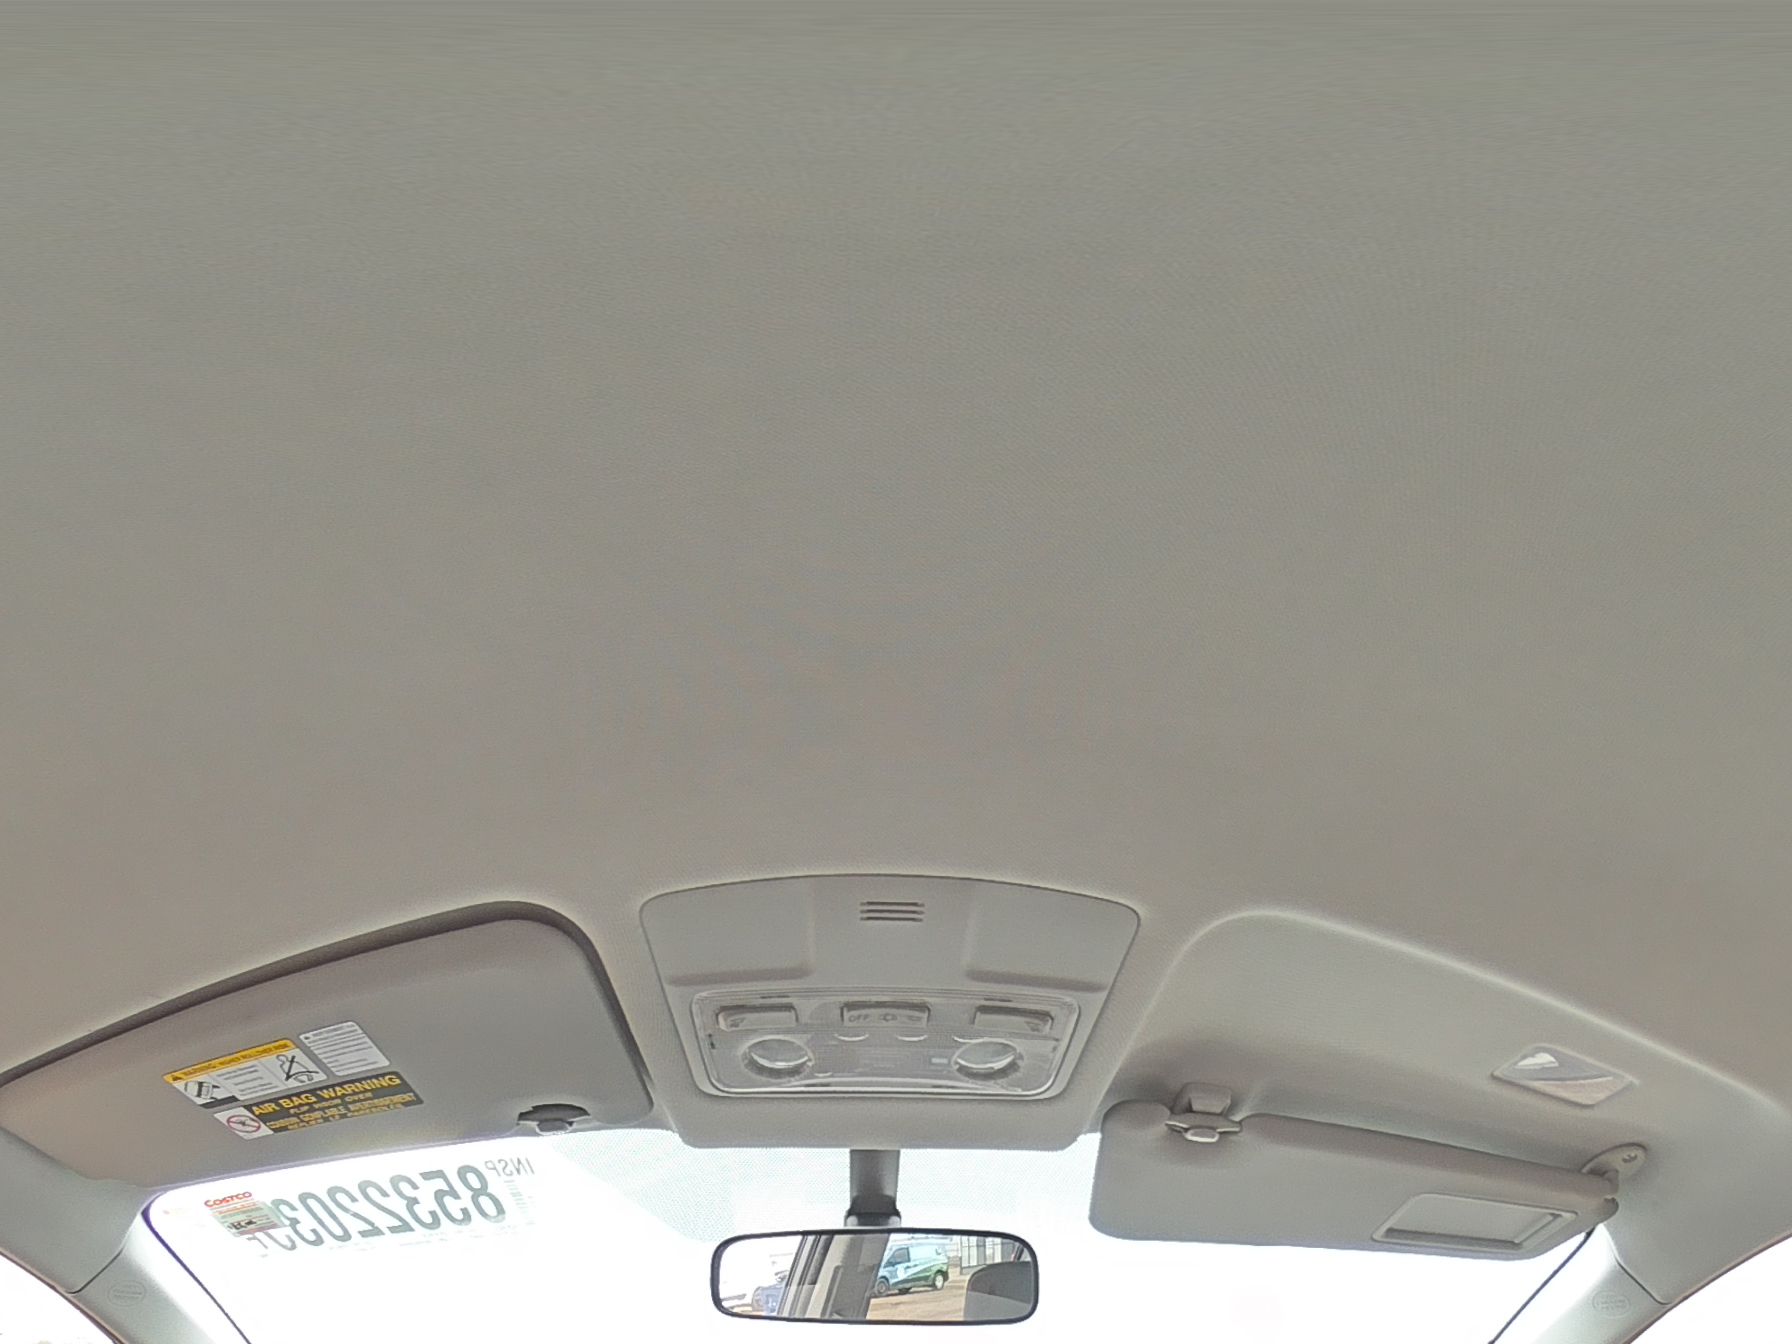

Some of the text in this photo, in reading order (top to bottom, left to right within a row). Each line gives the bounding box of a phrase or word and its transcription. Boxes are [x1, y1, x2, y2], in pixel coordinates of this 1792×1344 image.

[848, 1014, 870, 1023] OFF
[252, 1075, 402, 1116] AIR BAG WARNING
[203, 1191, 253, 1208] COSTCO
